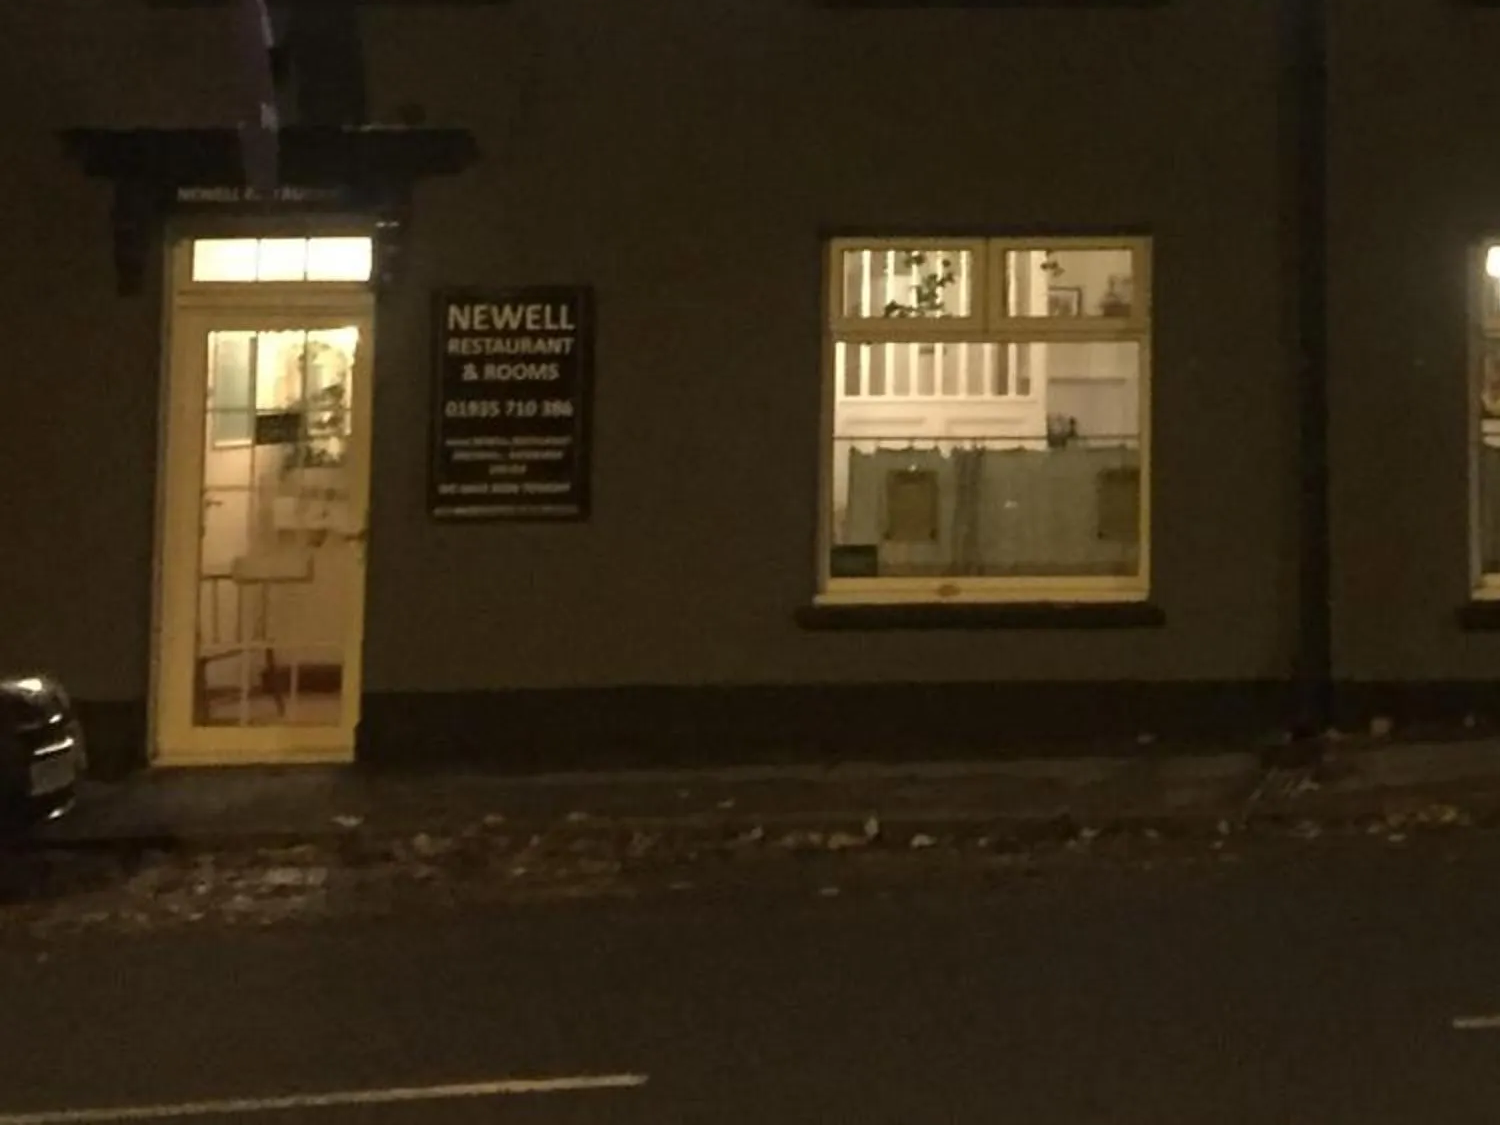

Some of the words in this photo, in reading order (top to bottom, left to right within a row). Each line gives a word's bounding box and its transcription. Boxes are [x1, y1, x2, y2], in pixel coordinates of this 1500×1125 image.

[448, 303, 576, 330] NEWELL
[447, 336, 575, 356] RESTAURANT
[462, 362, 479, 381] &
[484, 362, 560, 381] ROOMS
